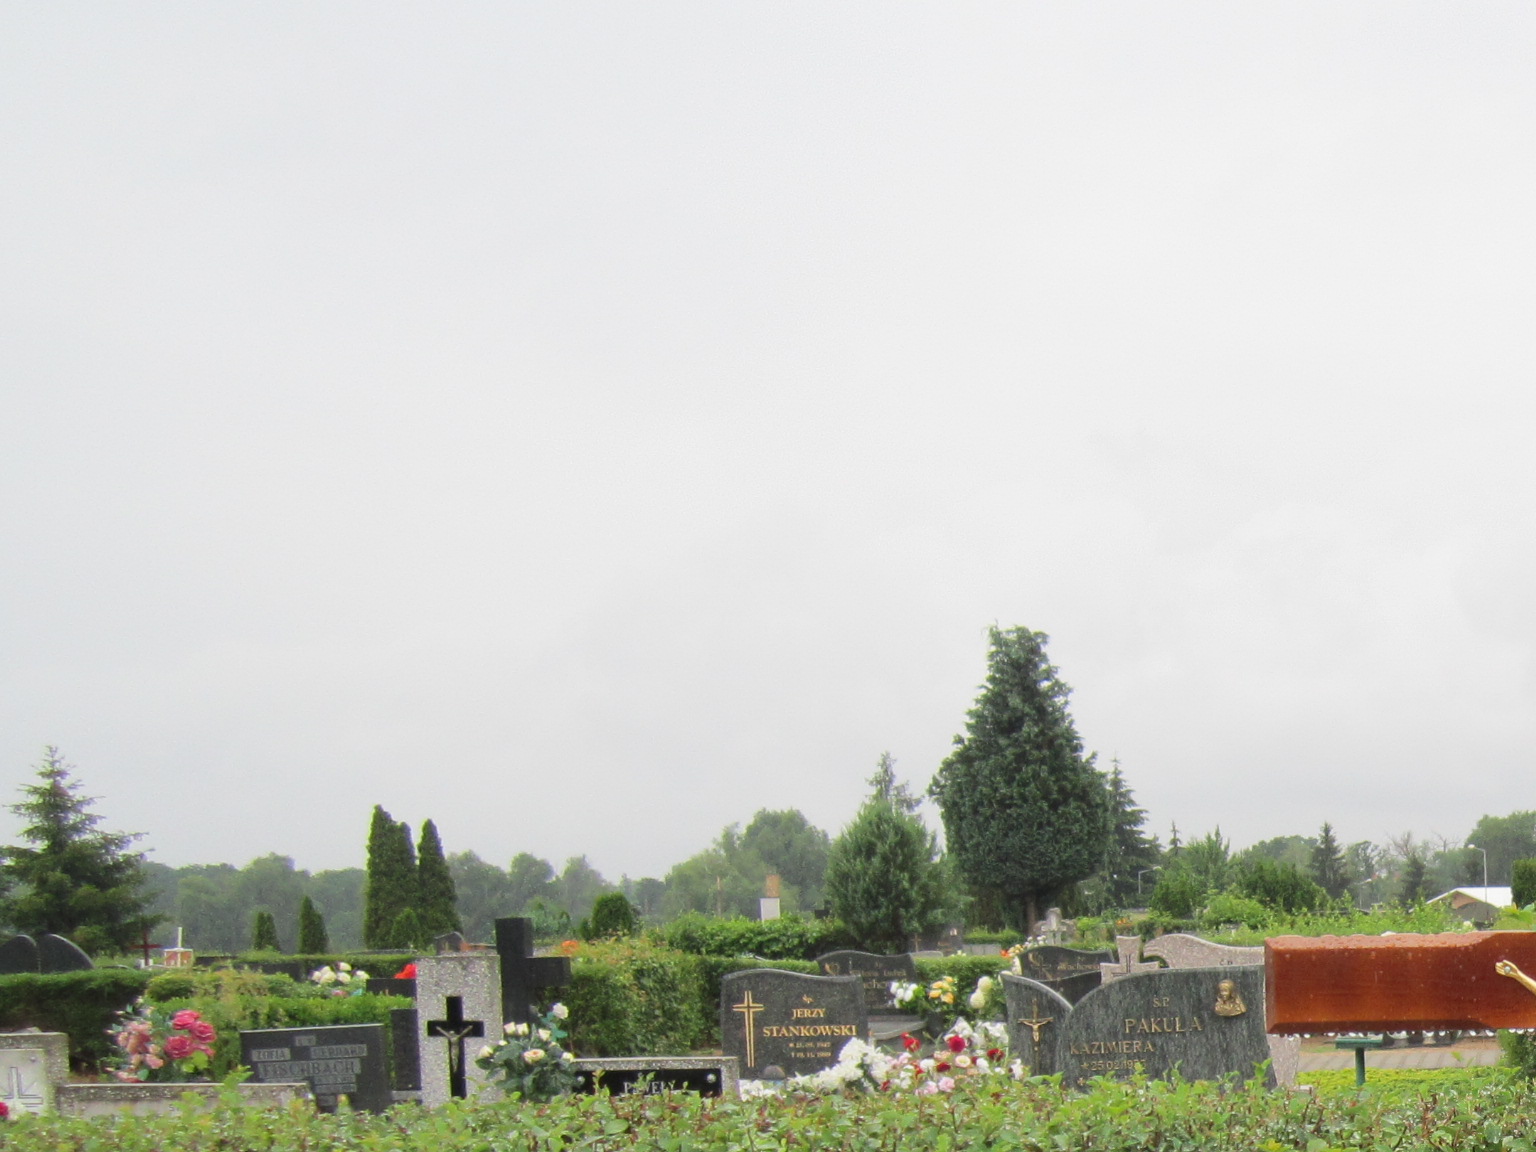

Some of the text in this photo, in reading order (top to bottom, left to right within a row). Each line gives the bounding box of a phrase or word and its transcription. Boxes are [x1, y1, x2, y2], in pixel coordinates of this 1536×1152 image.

[792, 1008, 826, 1019] JERZY
[763, 1025, 857, 1037] STANKOWSKI
[1124, 1016, 1203, 1034] PAKUŁA
[1070, 1040, 1155, 1055] KAZIMIERA
